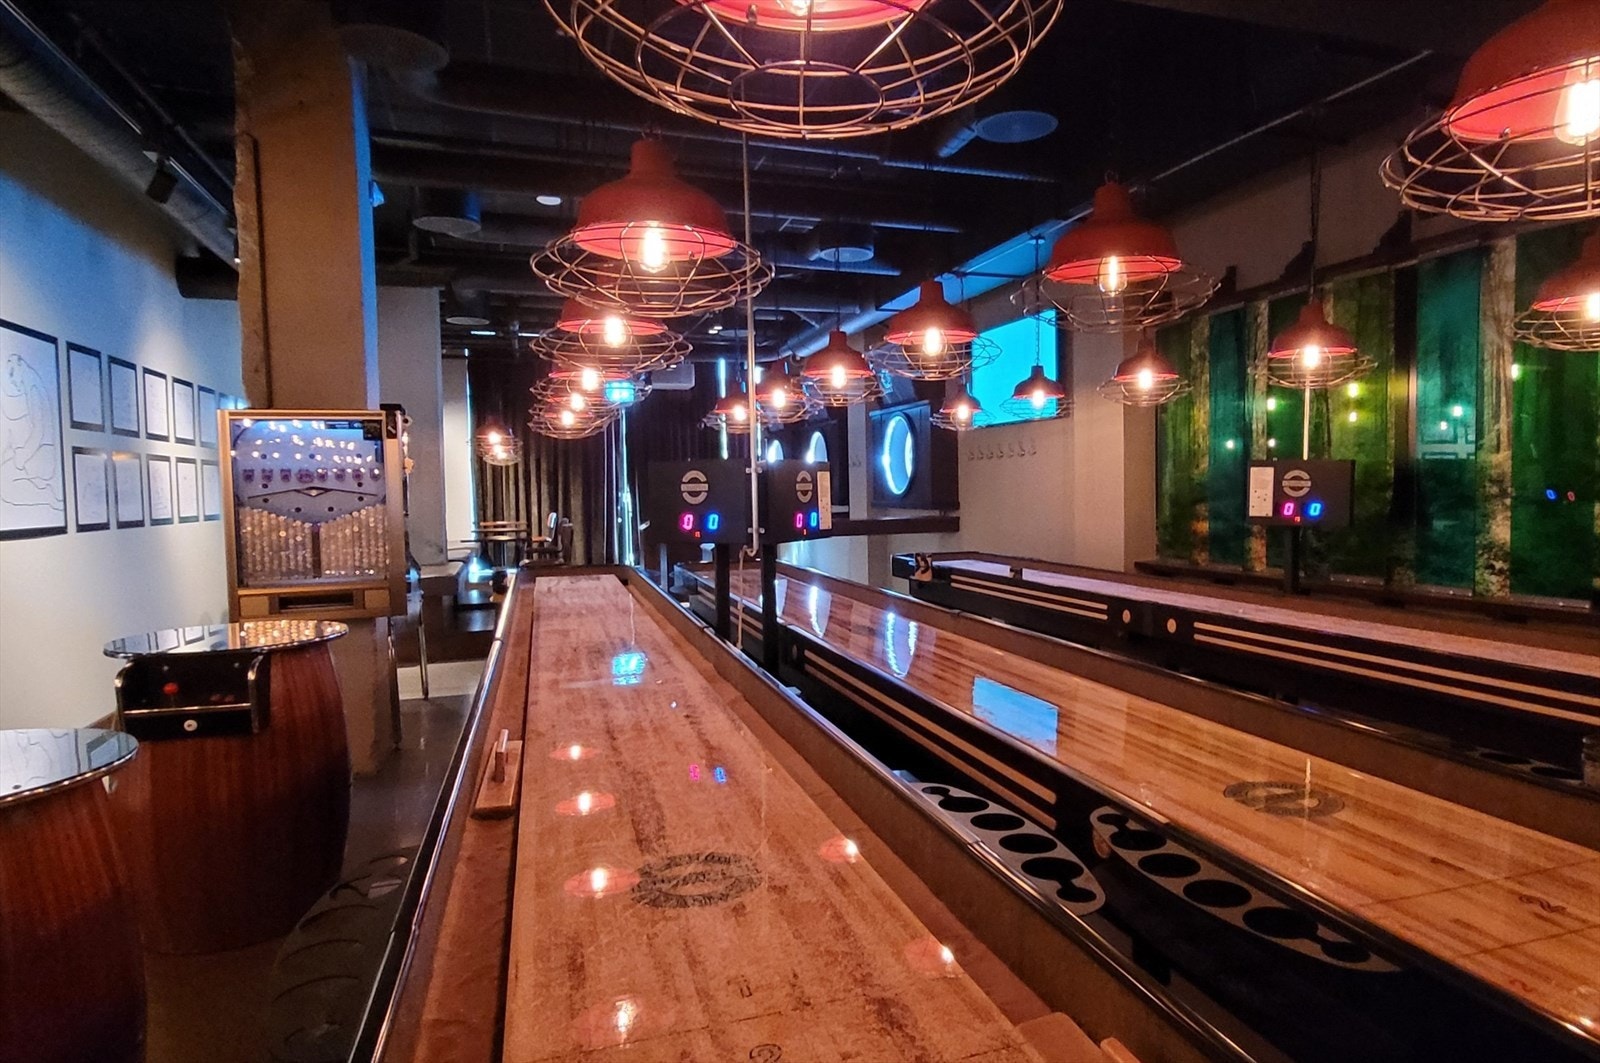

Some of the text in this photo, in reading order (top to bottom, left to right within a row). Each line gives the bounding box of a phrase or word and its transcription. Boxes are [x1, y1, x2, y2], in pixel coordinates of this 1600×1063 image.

[1283, 502, 1321, 516] 0 0
[683, 513, 719, 531] 0 0
[796, 511, 818, 528] 0 0
